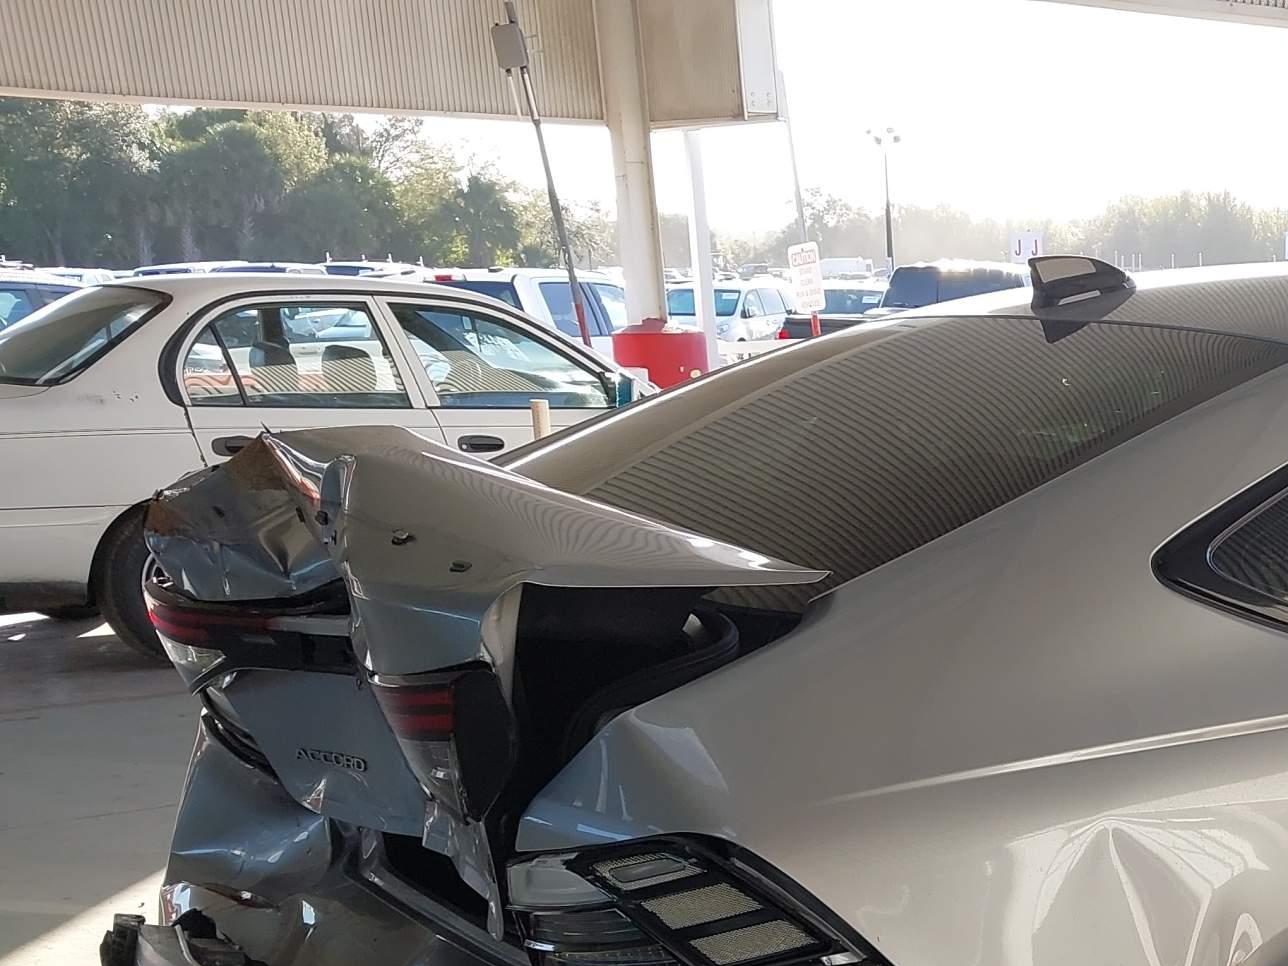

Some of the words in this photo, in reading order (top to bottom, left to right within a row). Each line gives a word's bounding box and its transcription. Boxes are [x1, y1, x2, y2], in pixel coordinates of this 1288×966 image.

[1014, 239, 1022, 257] J
[1031, 239, 1038, 257] J
[791, 250, 816, 267] CAUTION
[295, 748, 368, 772] ACCORD
